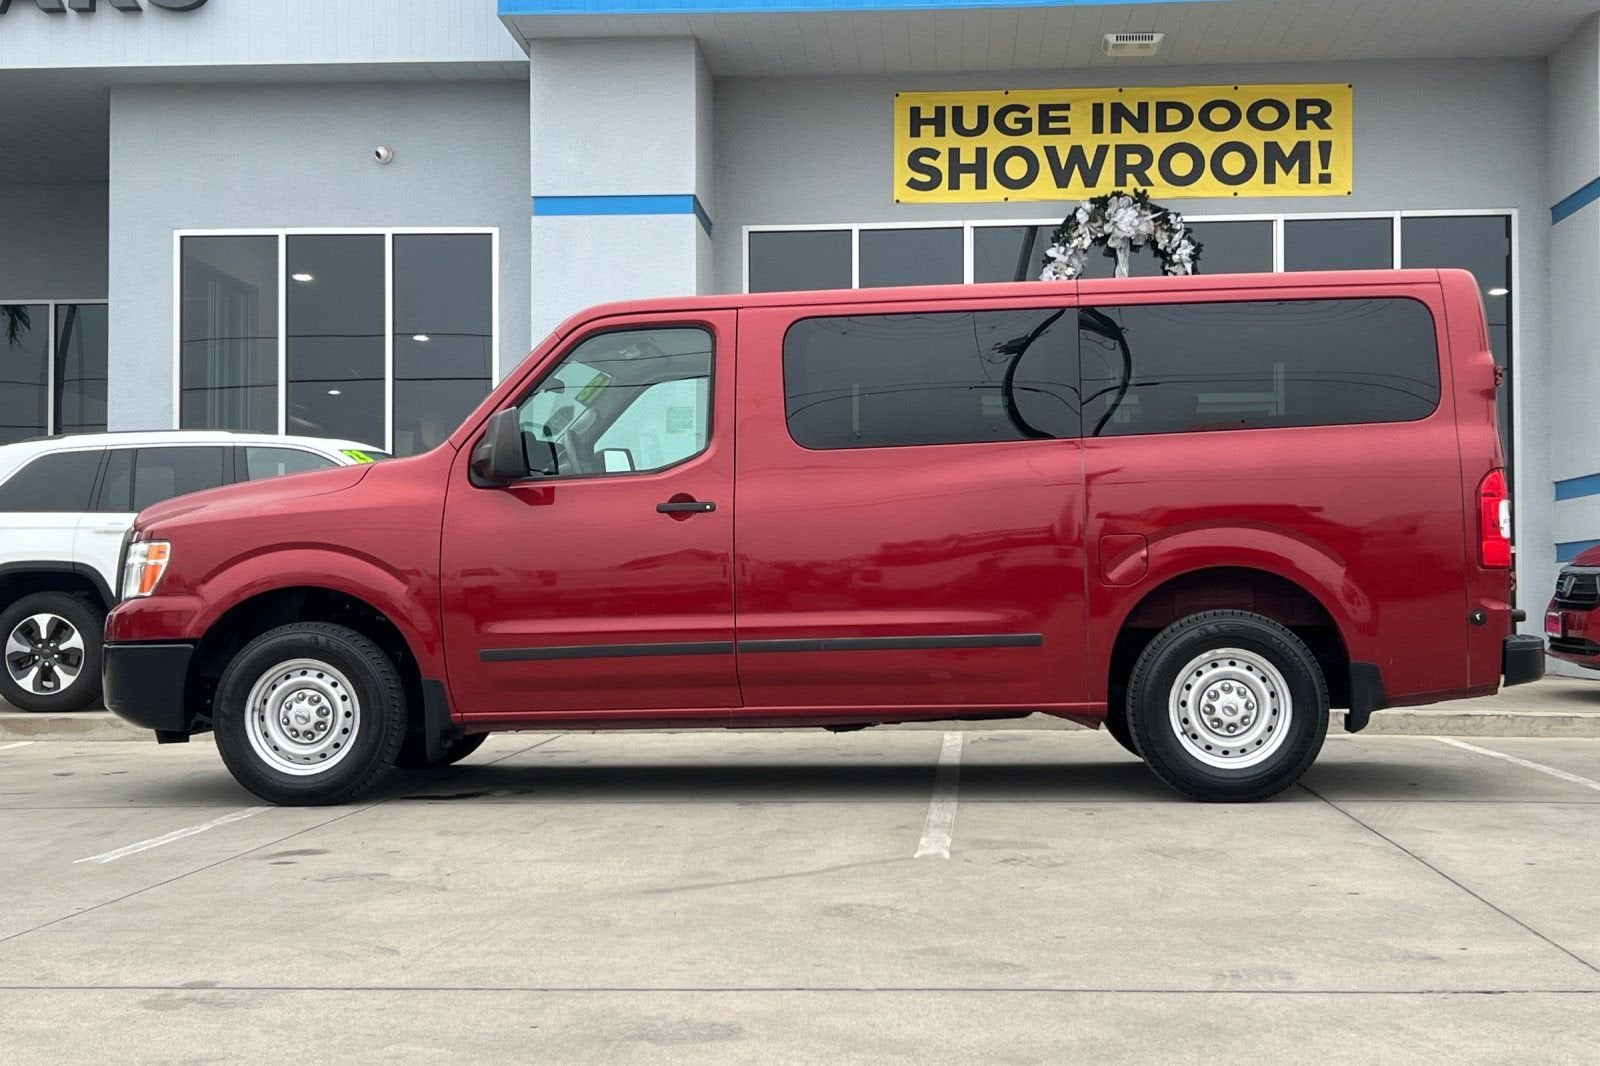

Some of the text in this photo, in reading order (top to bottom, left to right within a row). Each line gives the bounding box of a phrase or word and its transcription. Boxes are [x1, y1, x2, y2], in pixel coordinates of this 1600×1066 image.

[909, 98, 1333, 138] HUGE INDOOR
[905, 140, 1333, 192] SHOWROOM!
